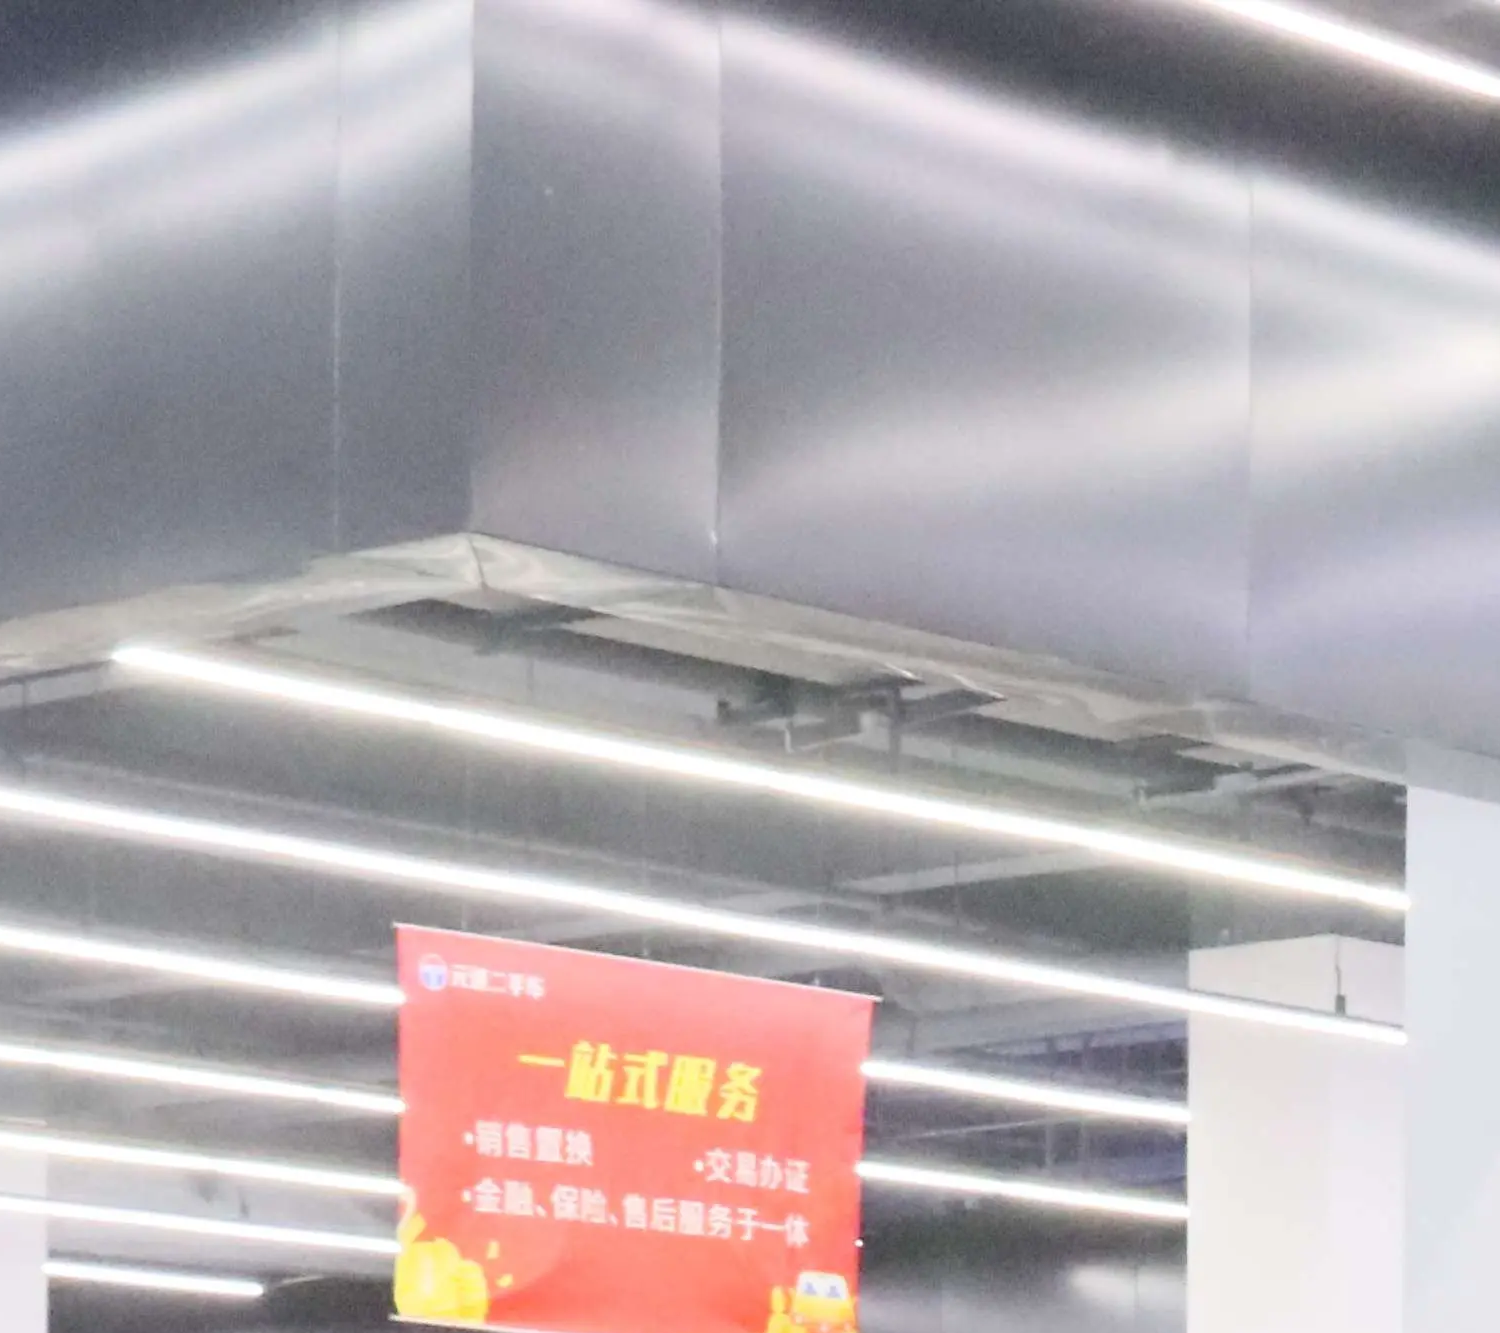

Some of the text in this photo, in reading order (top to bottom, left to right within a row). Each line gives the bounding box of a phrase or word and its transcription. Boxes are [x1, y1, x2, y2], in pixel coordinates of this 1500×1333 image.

[517, 1040, 762, 1122] 一站式服务
